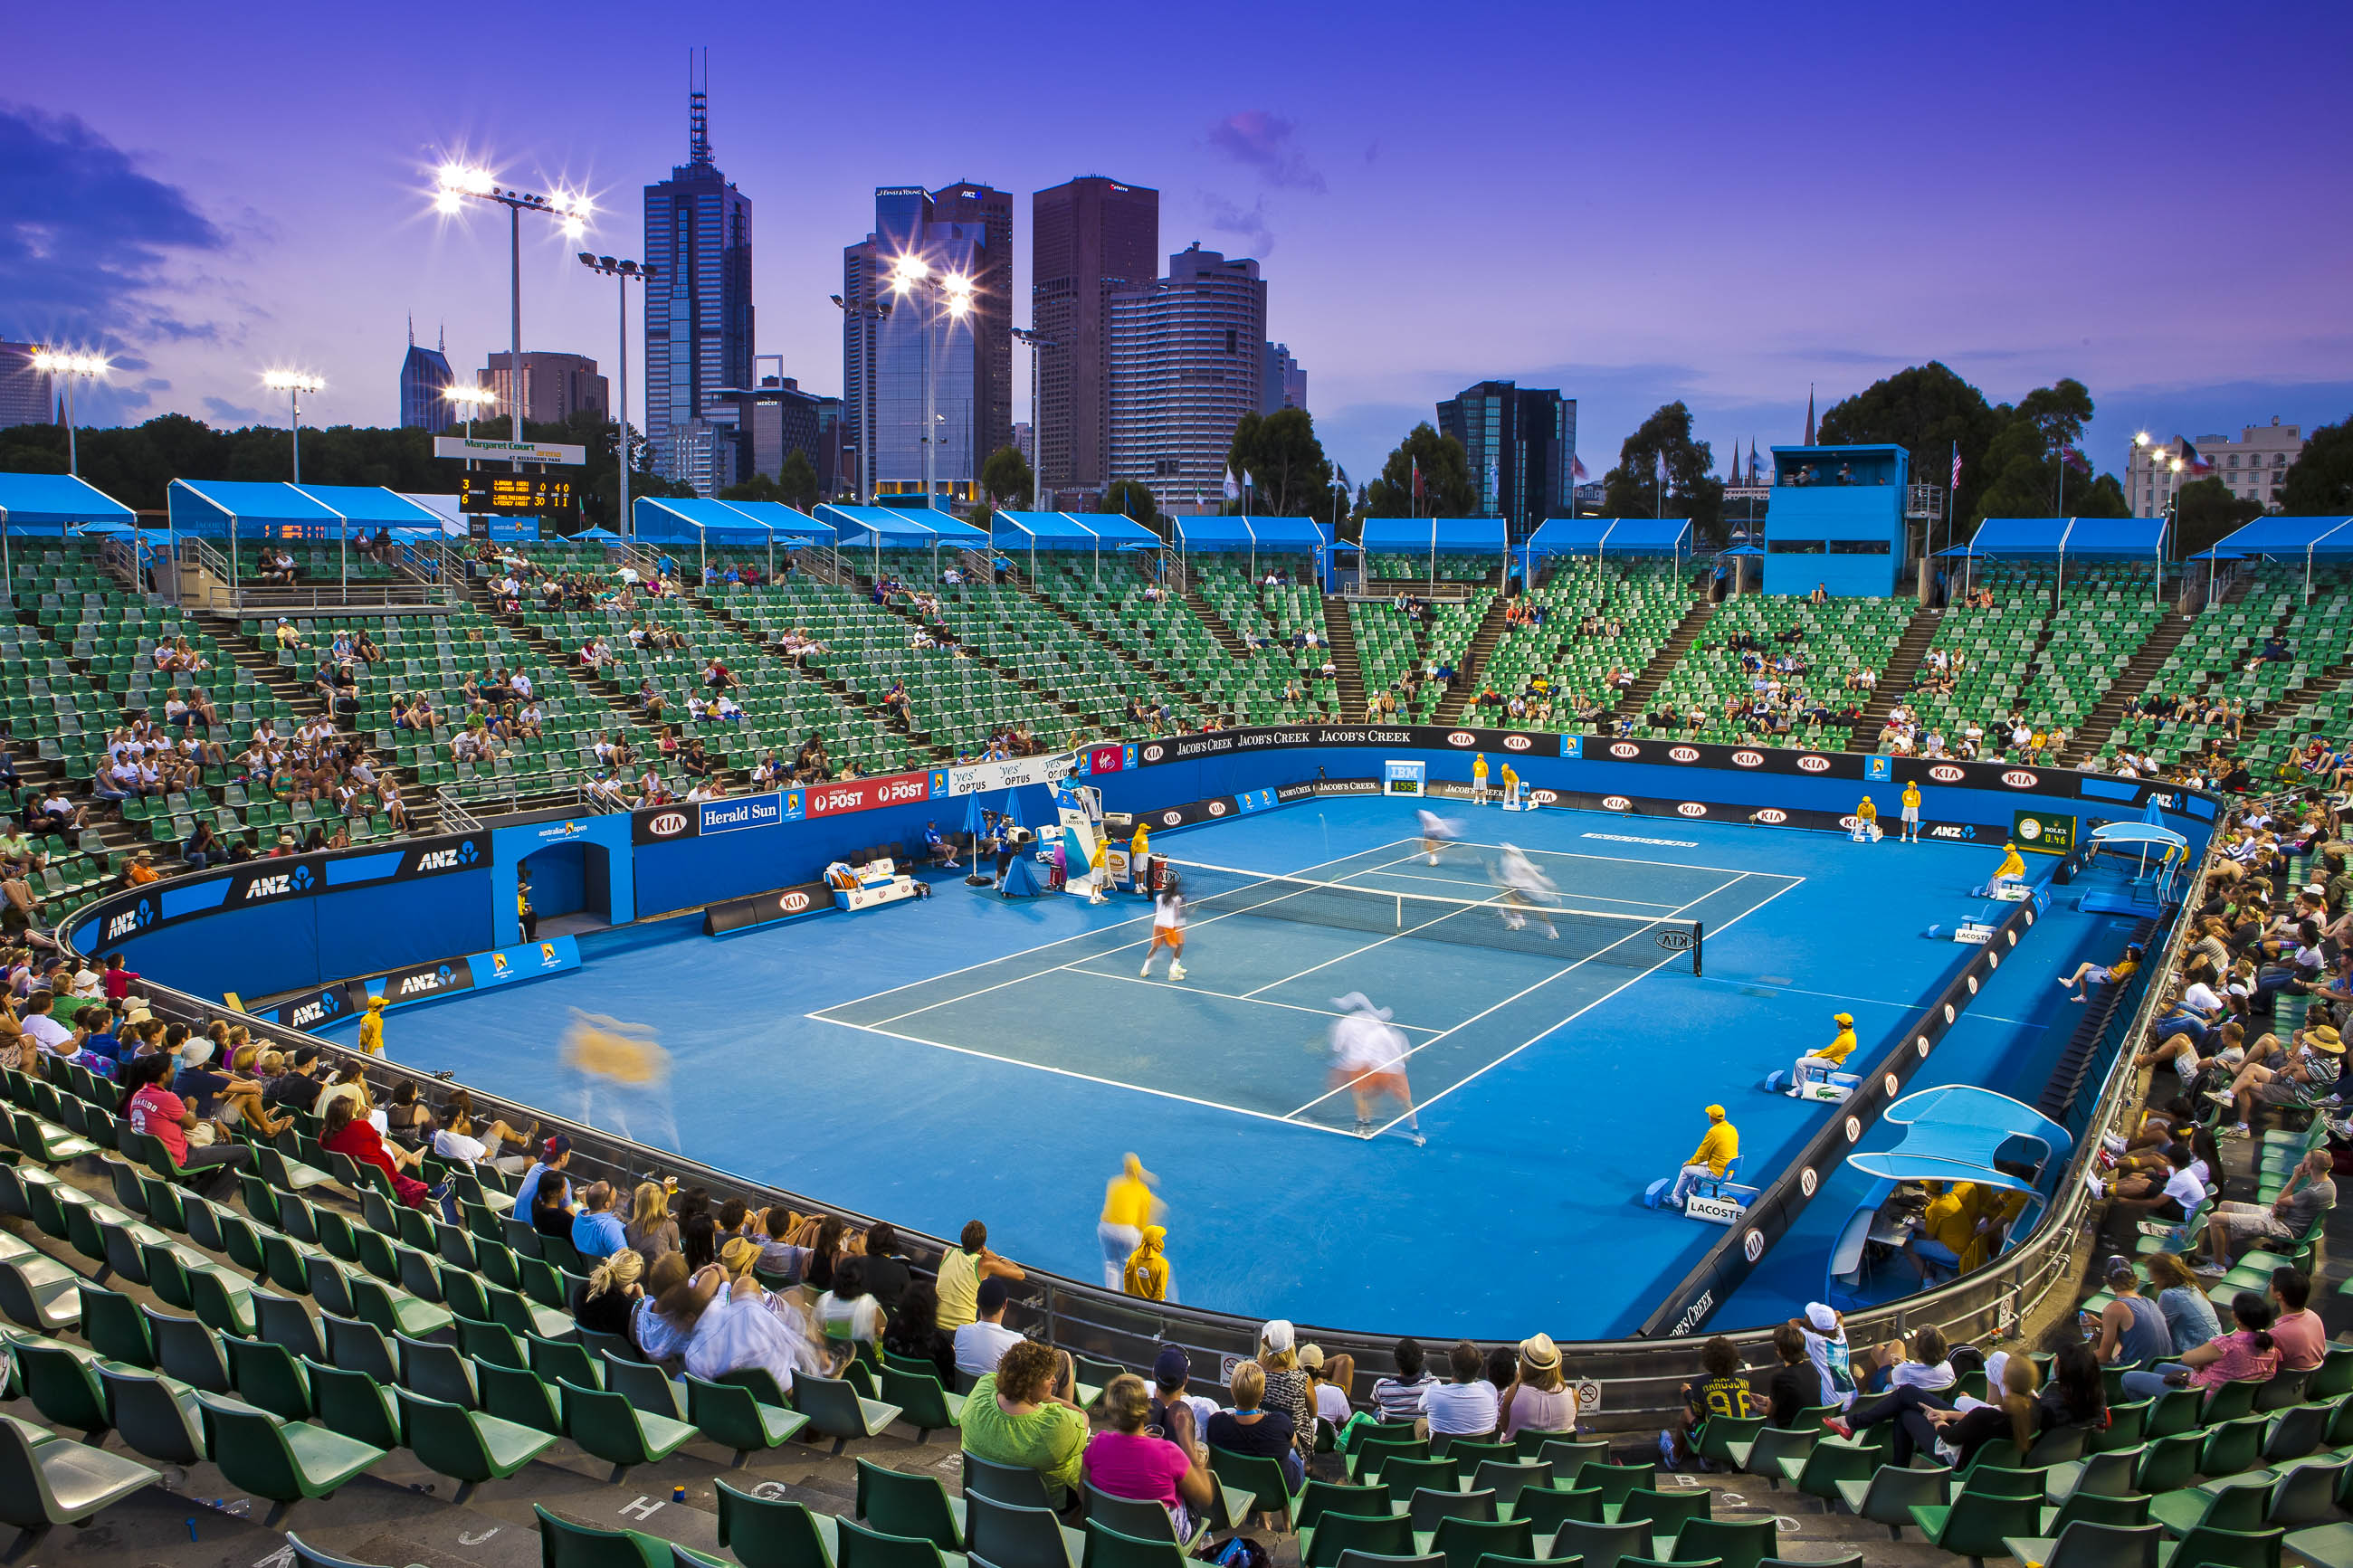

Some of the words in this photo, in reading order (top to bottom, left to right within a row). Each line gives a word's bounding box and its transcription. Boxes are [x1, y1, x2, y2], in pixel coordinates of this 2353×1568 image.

[464, 439, 507, 451] Margaret
[508, 442, 536, 451] Court
[462, 479, 470, 489] 3
[539, 482, 547, 491] 0
[555, 483, 560, 492] 4
[563, 483, 569, 492] 0
[462, 494, 469, 504] 6
[534, 496, 545, 506] 30
[554, 497, 558, 507] 1
[563, 498, 567, 507] 1
[1237, 735, 1272, 747] JACOB'S
[1273, 732, 1310, 744] CREEK
[1319, 730, 1365, 742] JACOB'S
[1368, 729, 1411, 743] CREEK
[1452, 734, 1471, 744] KIA
[1508, 737, 1527, 747] KIA
[1176, 742, 1207, 755] JACOB'S
[1207, 738, 1233, 751] CREEK
[1615, 746, 1634, 755] KIA
[1147, 747, 1161, 759] KIA
[1674, 749, 1695, 759] KIA
[1737, 754, 1758, 764] KIA
[1802, 758, 1825, 769] KIA
[1390, 766, 1418, 779] IBM
[1934, 768, 1958, 779] KIA
[1005, 774, 1031, 785] OPTUS
[2007, 774, 2032, 785] KIA
[891, 783, 924, 800] POST
[959, 781, 986, 793] OPTUS
[1296, 784, 1311, 795] CREEK
[1319, 782, 1349, 791] JACOB'S
[1350, 782, 1376, 791] CREEK
[1445, 784, 1476, 794] JACOB'S
[829, 792, 863, 810] POST
[1534, 792, 1553, 802] KIA
[1606, 798, 1625, 807] KIA
[704, 805, 748, 826] Herald
[752, 803, 776, 819] Sun
[1211, 803, 1224, 814] KIA
[1682, 805, 1703, 814] KIA
[1167, 814, 1179, 824] KIA
[1761, 812, 1783, 821] KIA
[655, 816, 682, 832] KIA
[2043, 826, 2067, 834] ROLEX
[538, 826, 566, 837] australian
[574, 824, 587, 833] open
[1931, 825, 1962, 838] ANZ
[416, 849, 458, 871] ANZ
[245, 874, 291, 899] ANZ
[784, 895, 806, 908] KIA
[108, 909, 137, 940] ANZ
[1957, 932, 1989, 941] LACOSTE
[400, 972, 439, 995] ANZ
[292, 999, 325, 1028] ANZ
[1847, 1119, 1860, 1140] KIA
[1803, 1172, 1816, 1195] KIA
[1691, 1202, 1743, 1221] LACOSTE
[1746, 1233, 1764, 1259] KIA
[1687, 1288, 1714, 1326] CREEK
[1674, 1475, 1700, 1487] B
[751, 1481, 786, 1500] G
[1721, 1493, 1748, 1507] C
[617, 1496, 666, 1521] H
[1772, 1516, 1802, 1532] D
